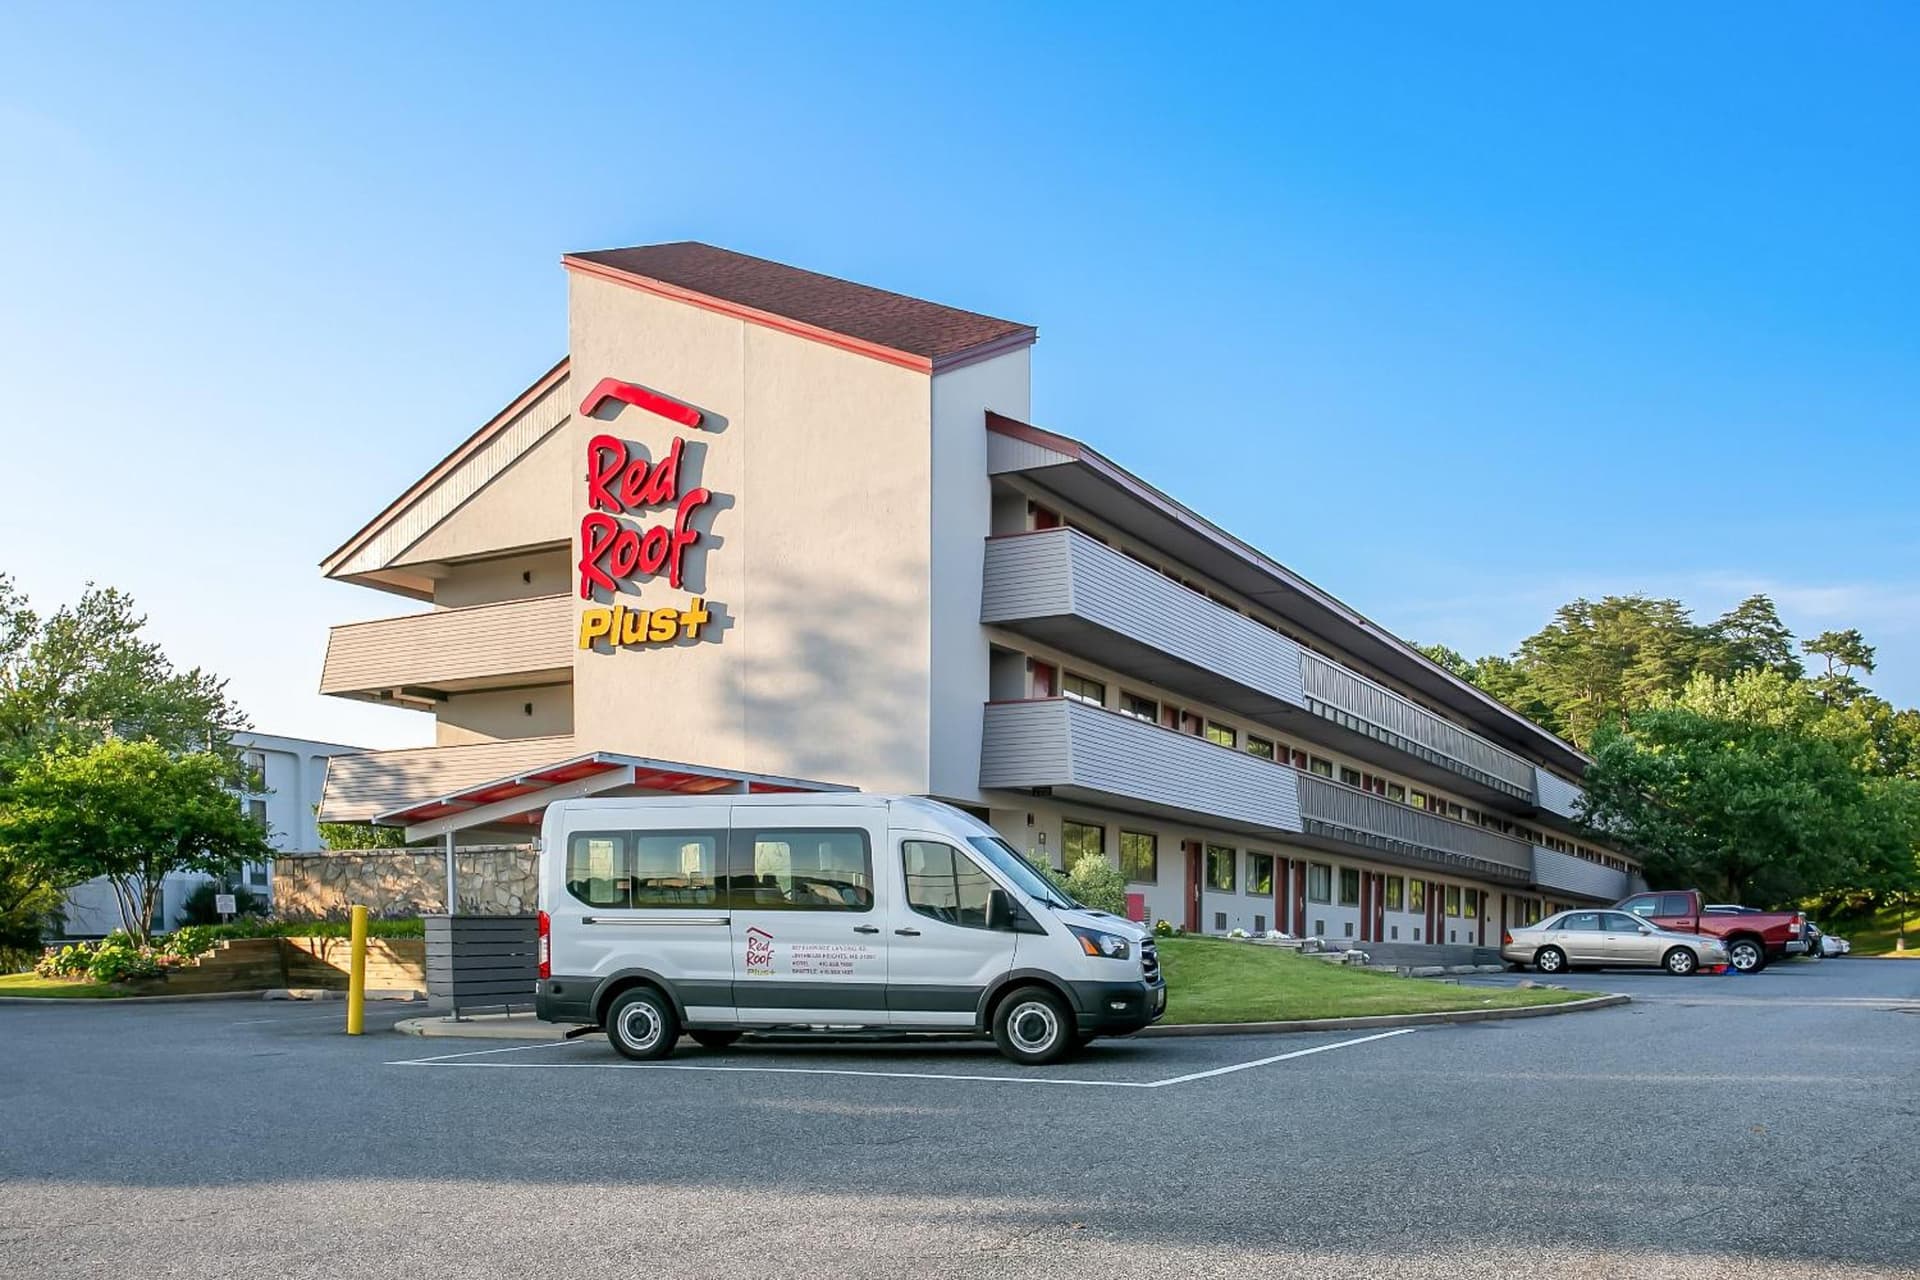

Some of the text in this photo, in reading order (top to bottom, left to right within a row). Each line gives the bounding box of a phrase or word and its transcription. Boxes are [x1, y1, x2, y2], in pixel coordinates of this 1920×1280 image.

[587, 434, 685, 514] Red
[579, 488, 711, 600] Roof
[579, 597, 710, 650] Plus+
[746, 950, 775, 967] Roof
[748, 936, 770, 951] Red
